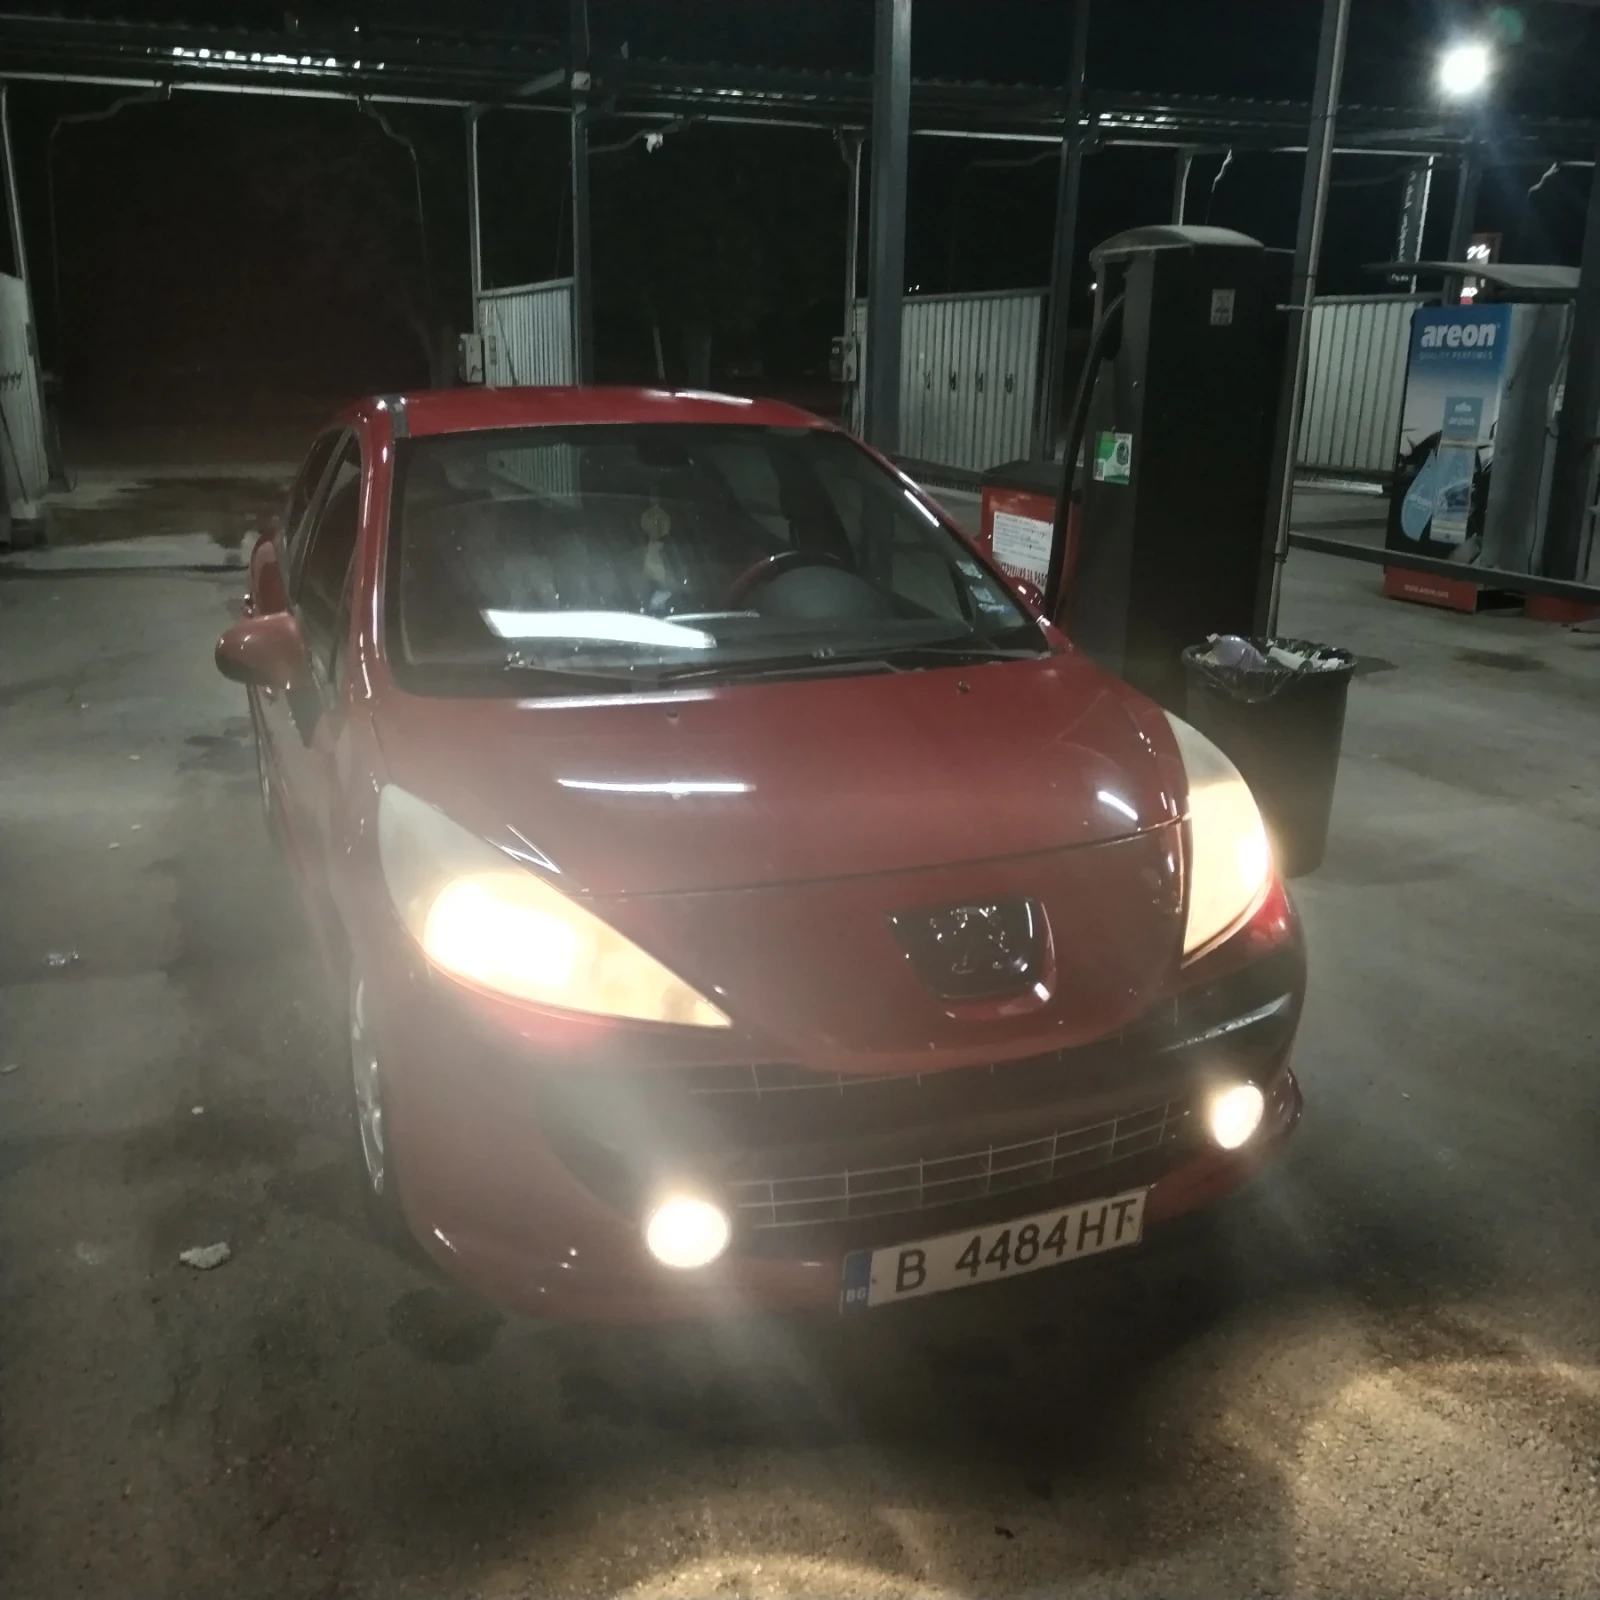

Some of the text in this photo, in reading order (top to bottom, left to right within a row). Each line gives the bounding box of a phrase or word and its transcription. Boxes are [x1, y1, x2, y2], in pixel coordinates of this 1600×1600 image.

[1421, 323, 1497, 348] areon
[1452, 351, 1493, 361] PERFUMES
[895, 1248, 927, 1293] B
[845, 1285, 867, 1302] BG
